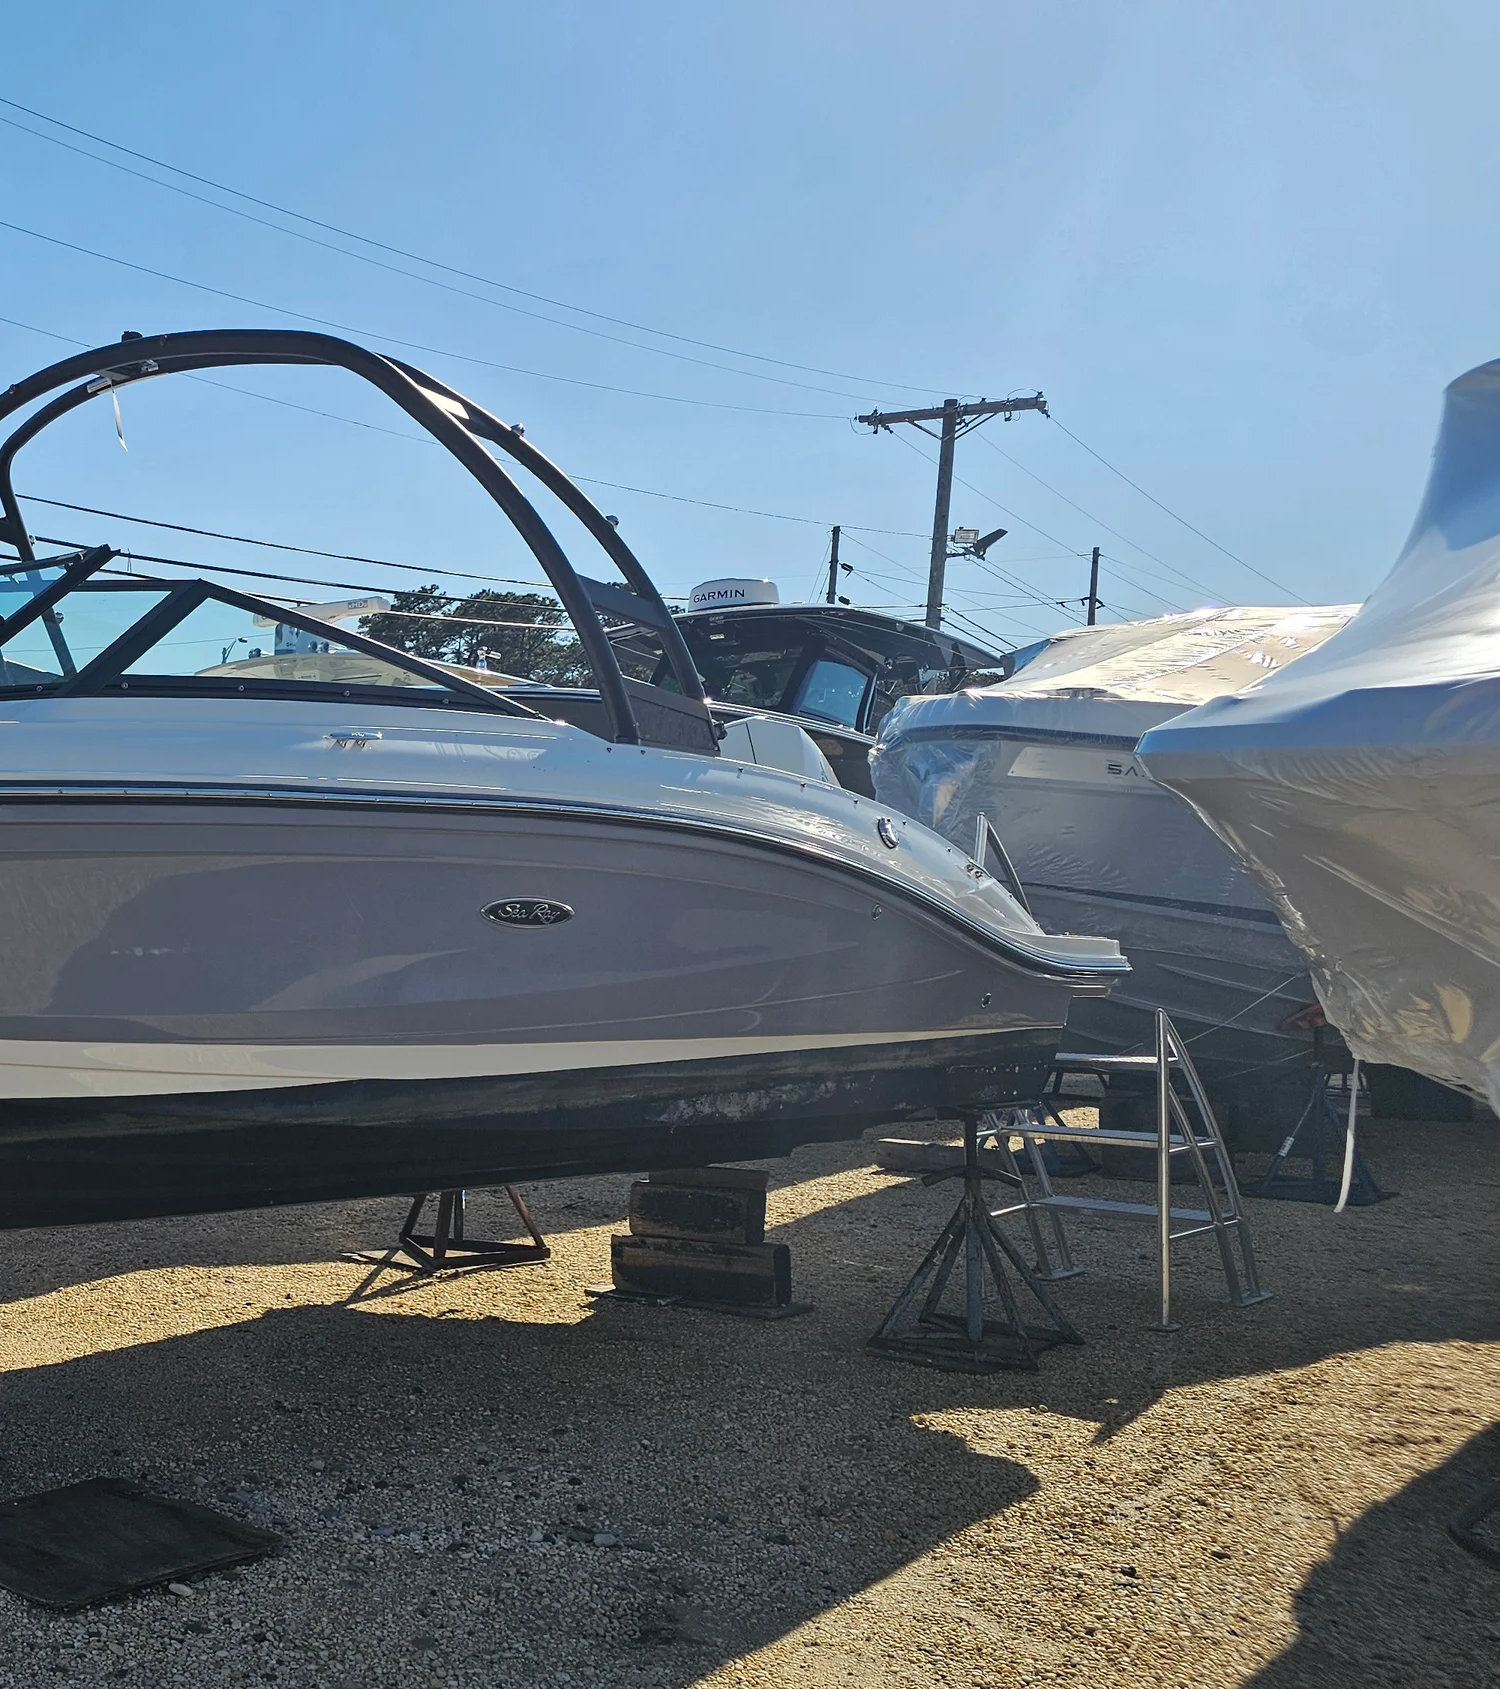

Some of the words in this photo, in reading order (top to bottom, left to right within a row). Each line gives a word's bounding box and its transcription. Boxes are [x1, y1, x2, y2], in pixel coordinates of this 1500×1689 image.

[693, 589, 745, 603] GARMIN
[1107, 763, 1145, 778] SA
[498, 903, 528, 919] Sea
[528, 903, 560, 924] Ray
